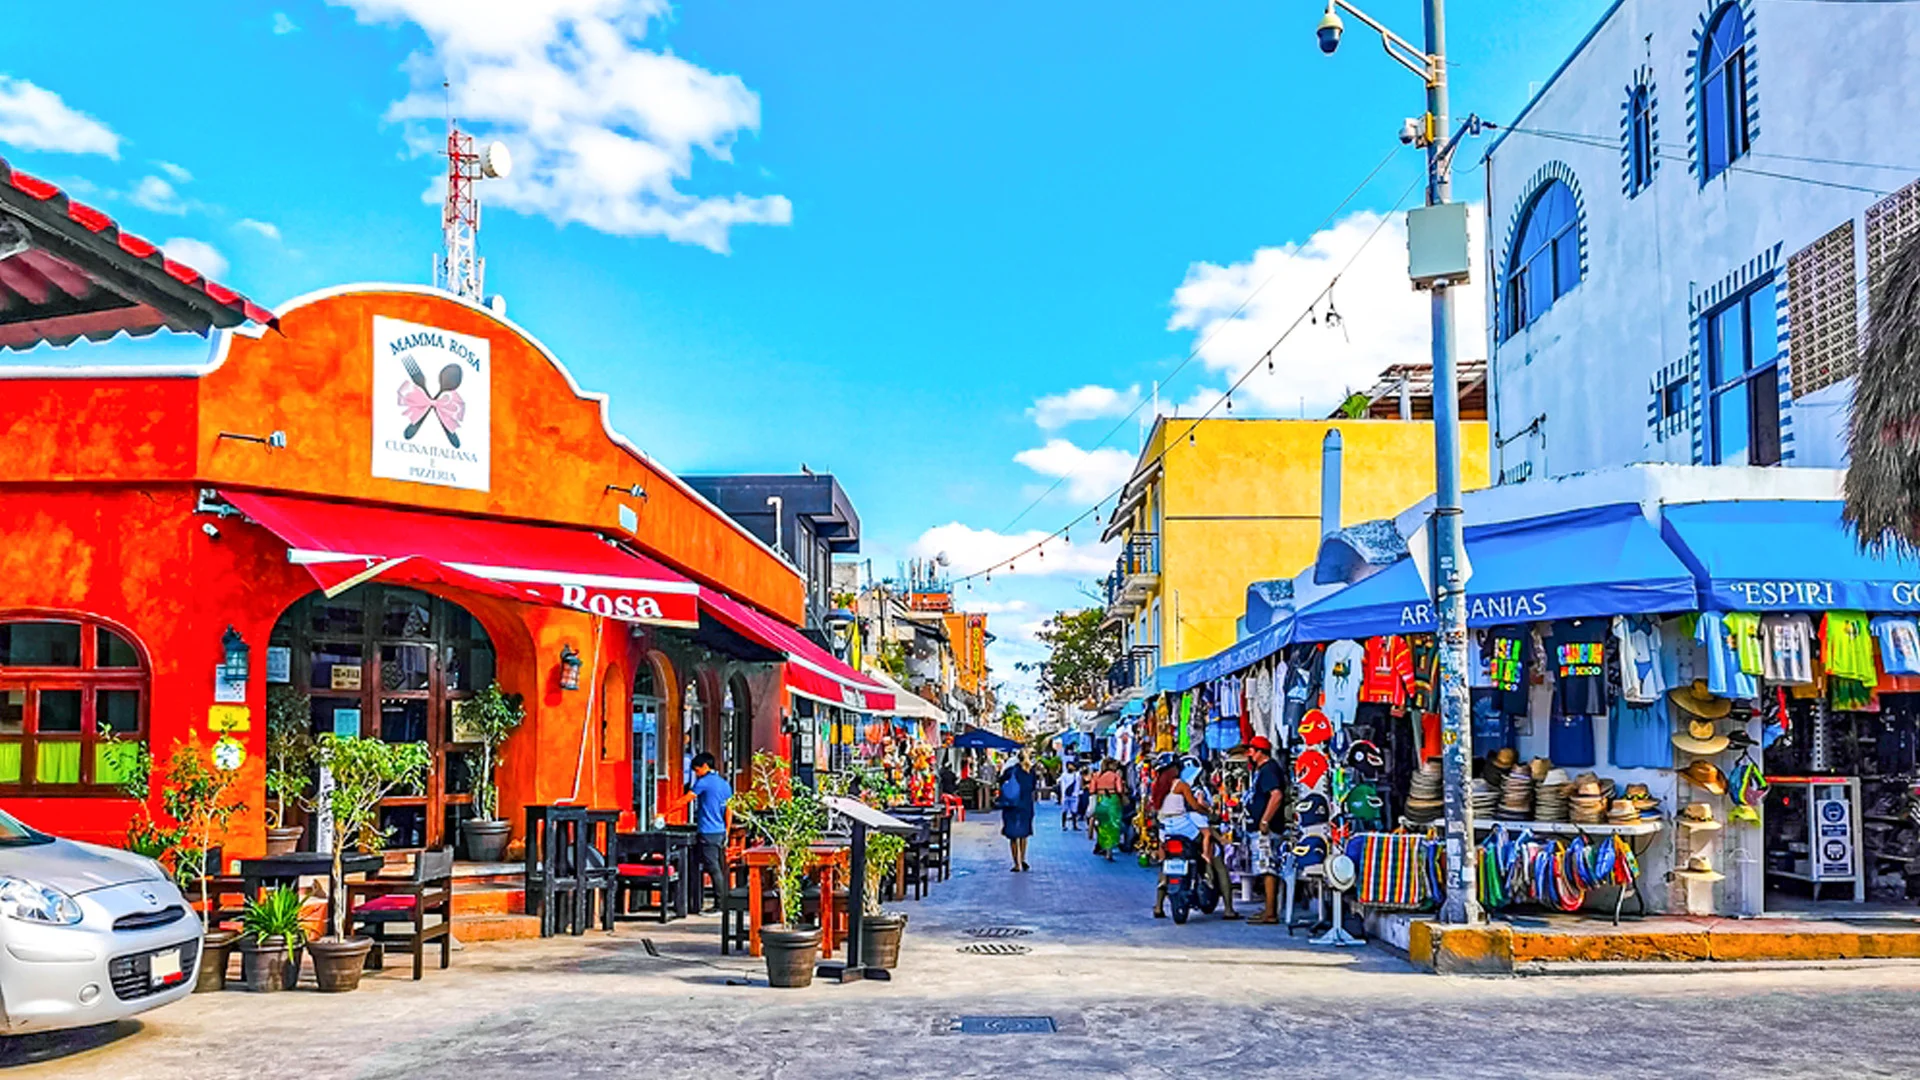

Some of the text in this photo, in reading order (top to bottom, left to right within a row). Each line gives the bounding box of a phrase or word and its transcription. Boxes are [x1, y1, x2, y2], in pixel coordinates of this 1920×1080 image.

[389, 332, 481, 373] MAMMA ROSA
[385, 440, 478, 464] CUCINA ITALIANA
[409, 466, 457, 483] PIZZERIA
[560, 583, 663, 618] Rosa
[1401, 593, 1548, 627] ARANIAS
